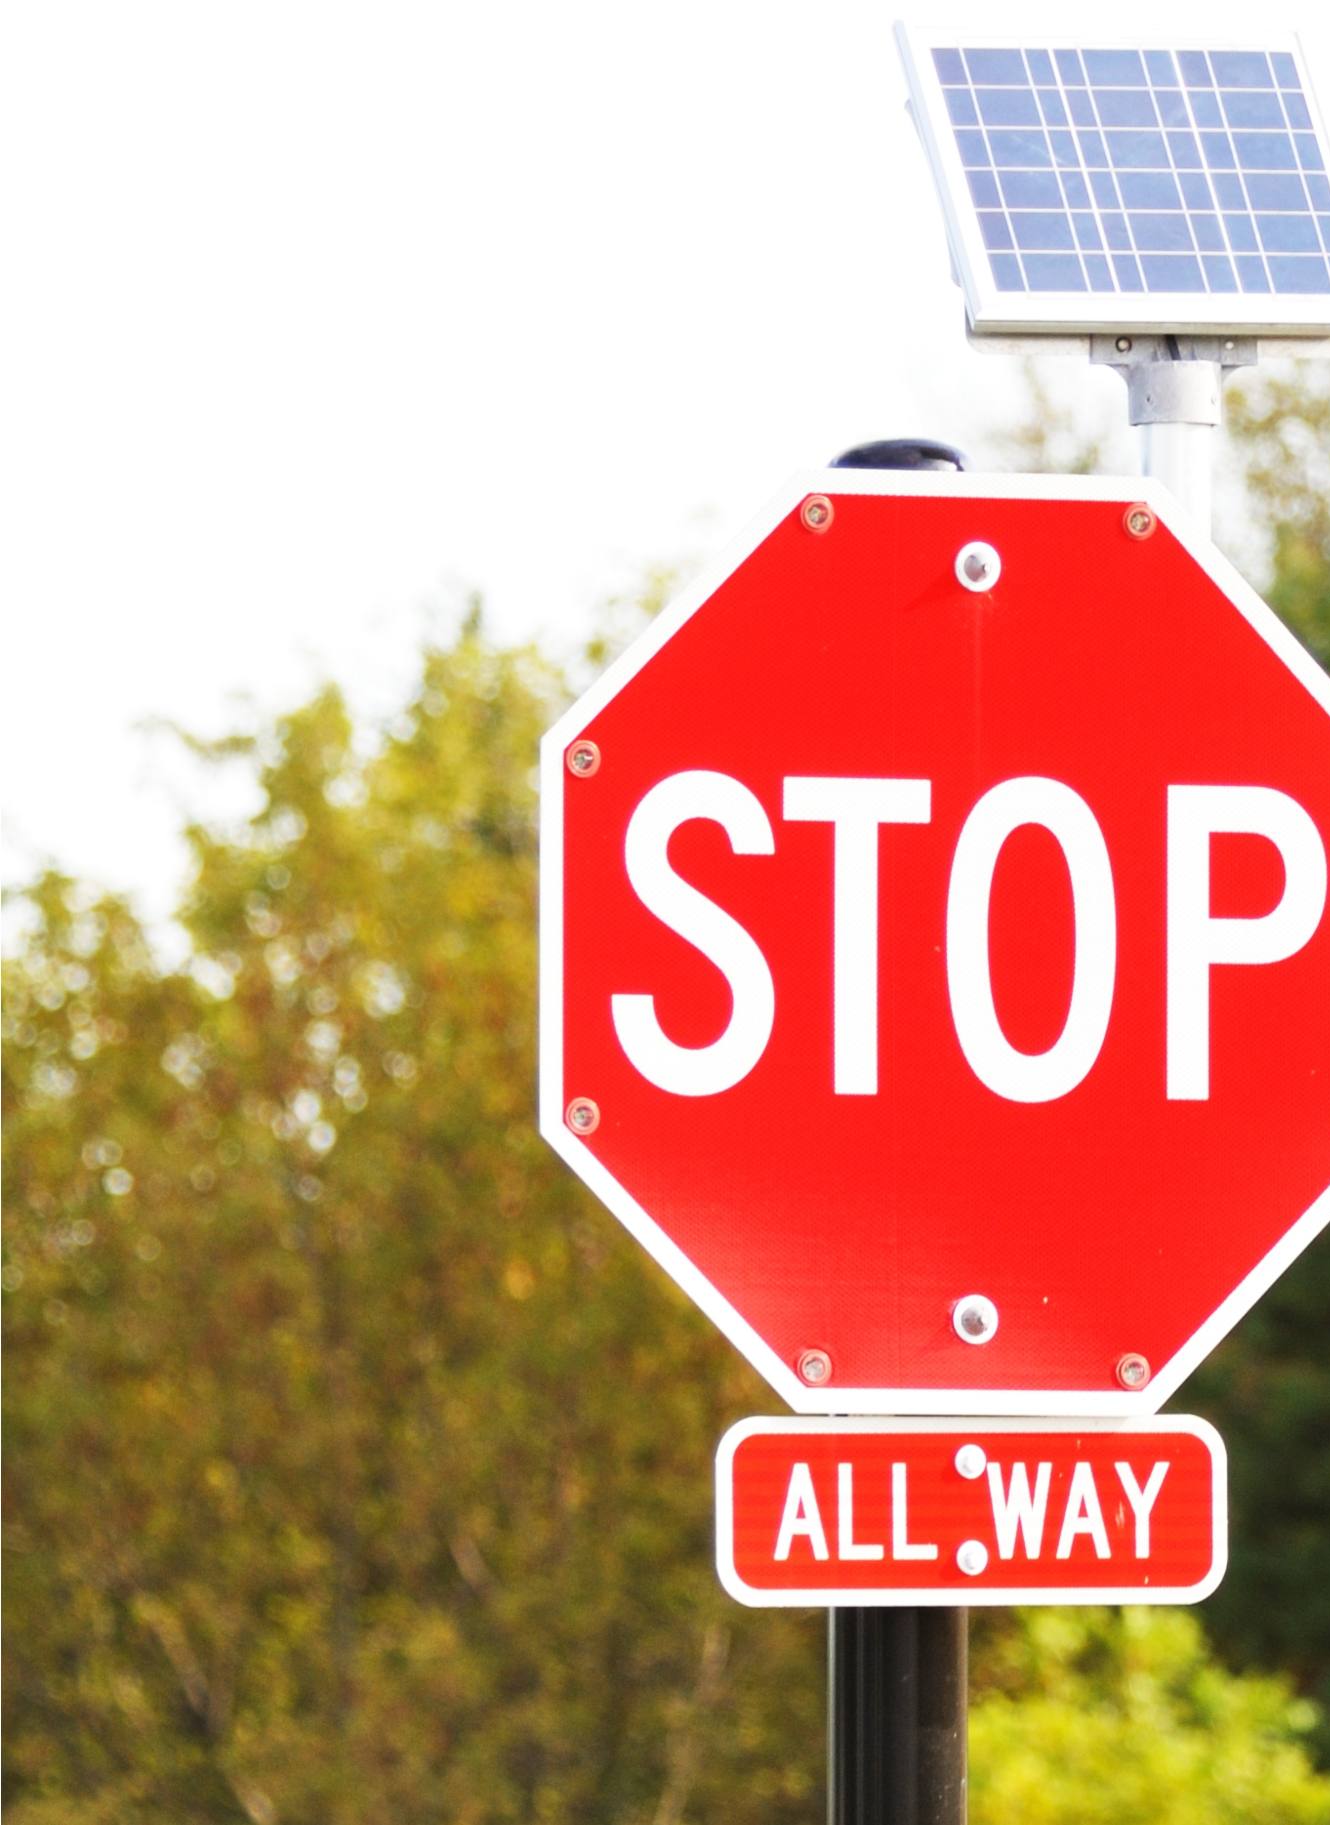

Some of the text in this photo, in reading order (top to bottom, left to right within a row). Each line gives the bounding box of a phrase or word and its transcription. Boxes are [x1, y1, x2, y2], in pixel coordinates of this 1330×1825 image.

[610, 769, 1328, 1104] STOP
[773, 1460, 1171, 1562] ALL WAY
